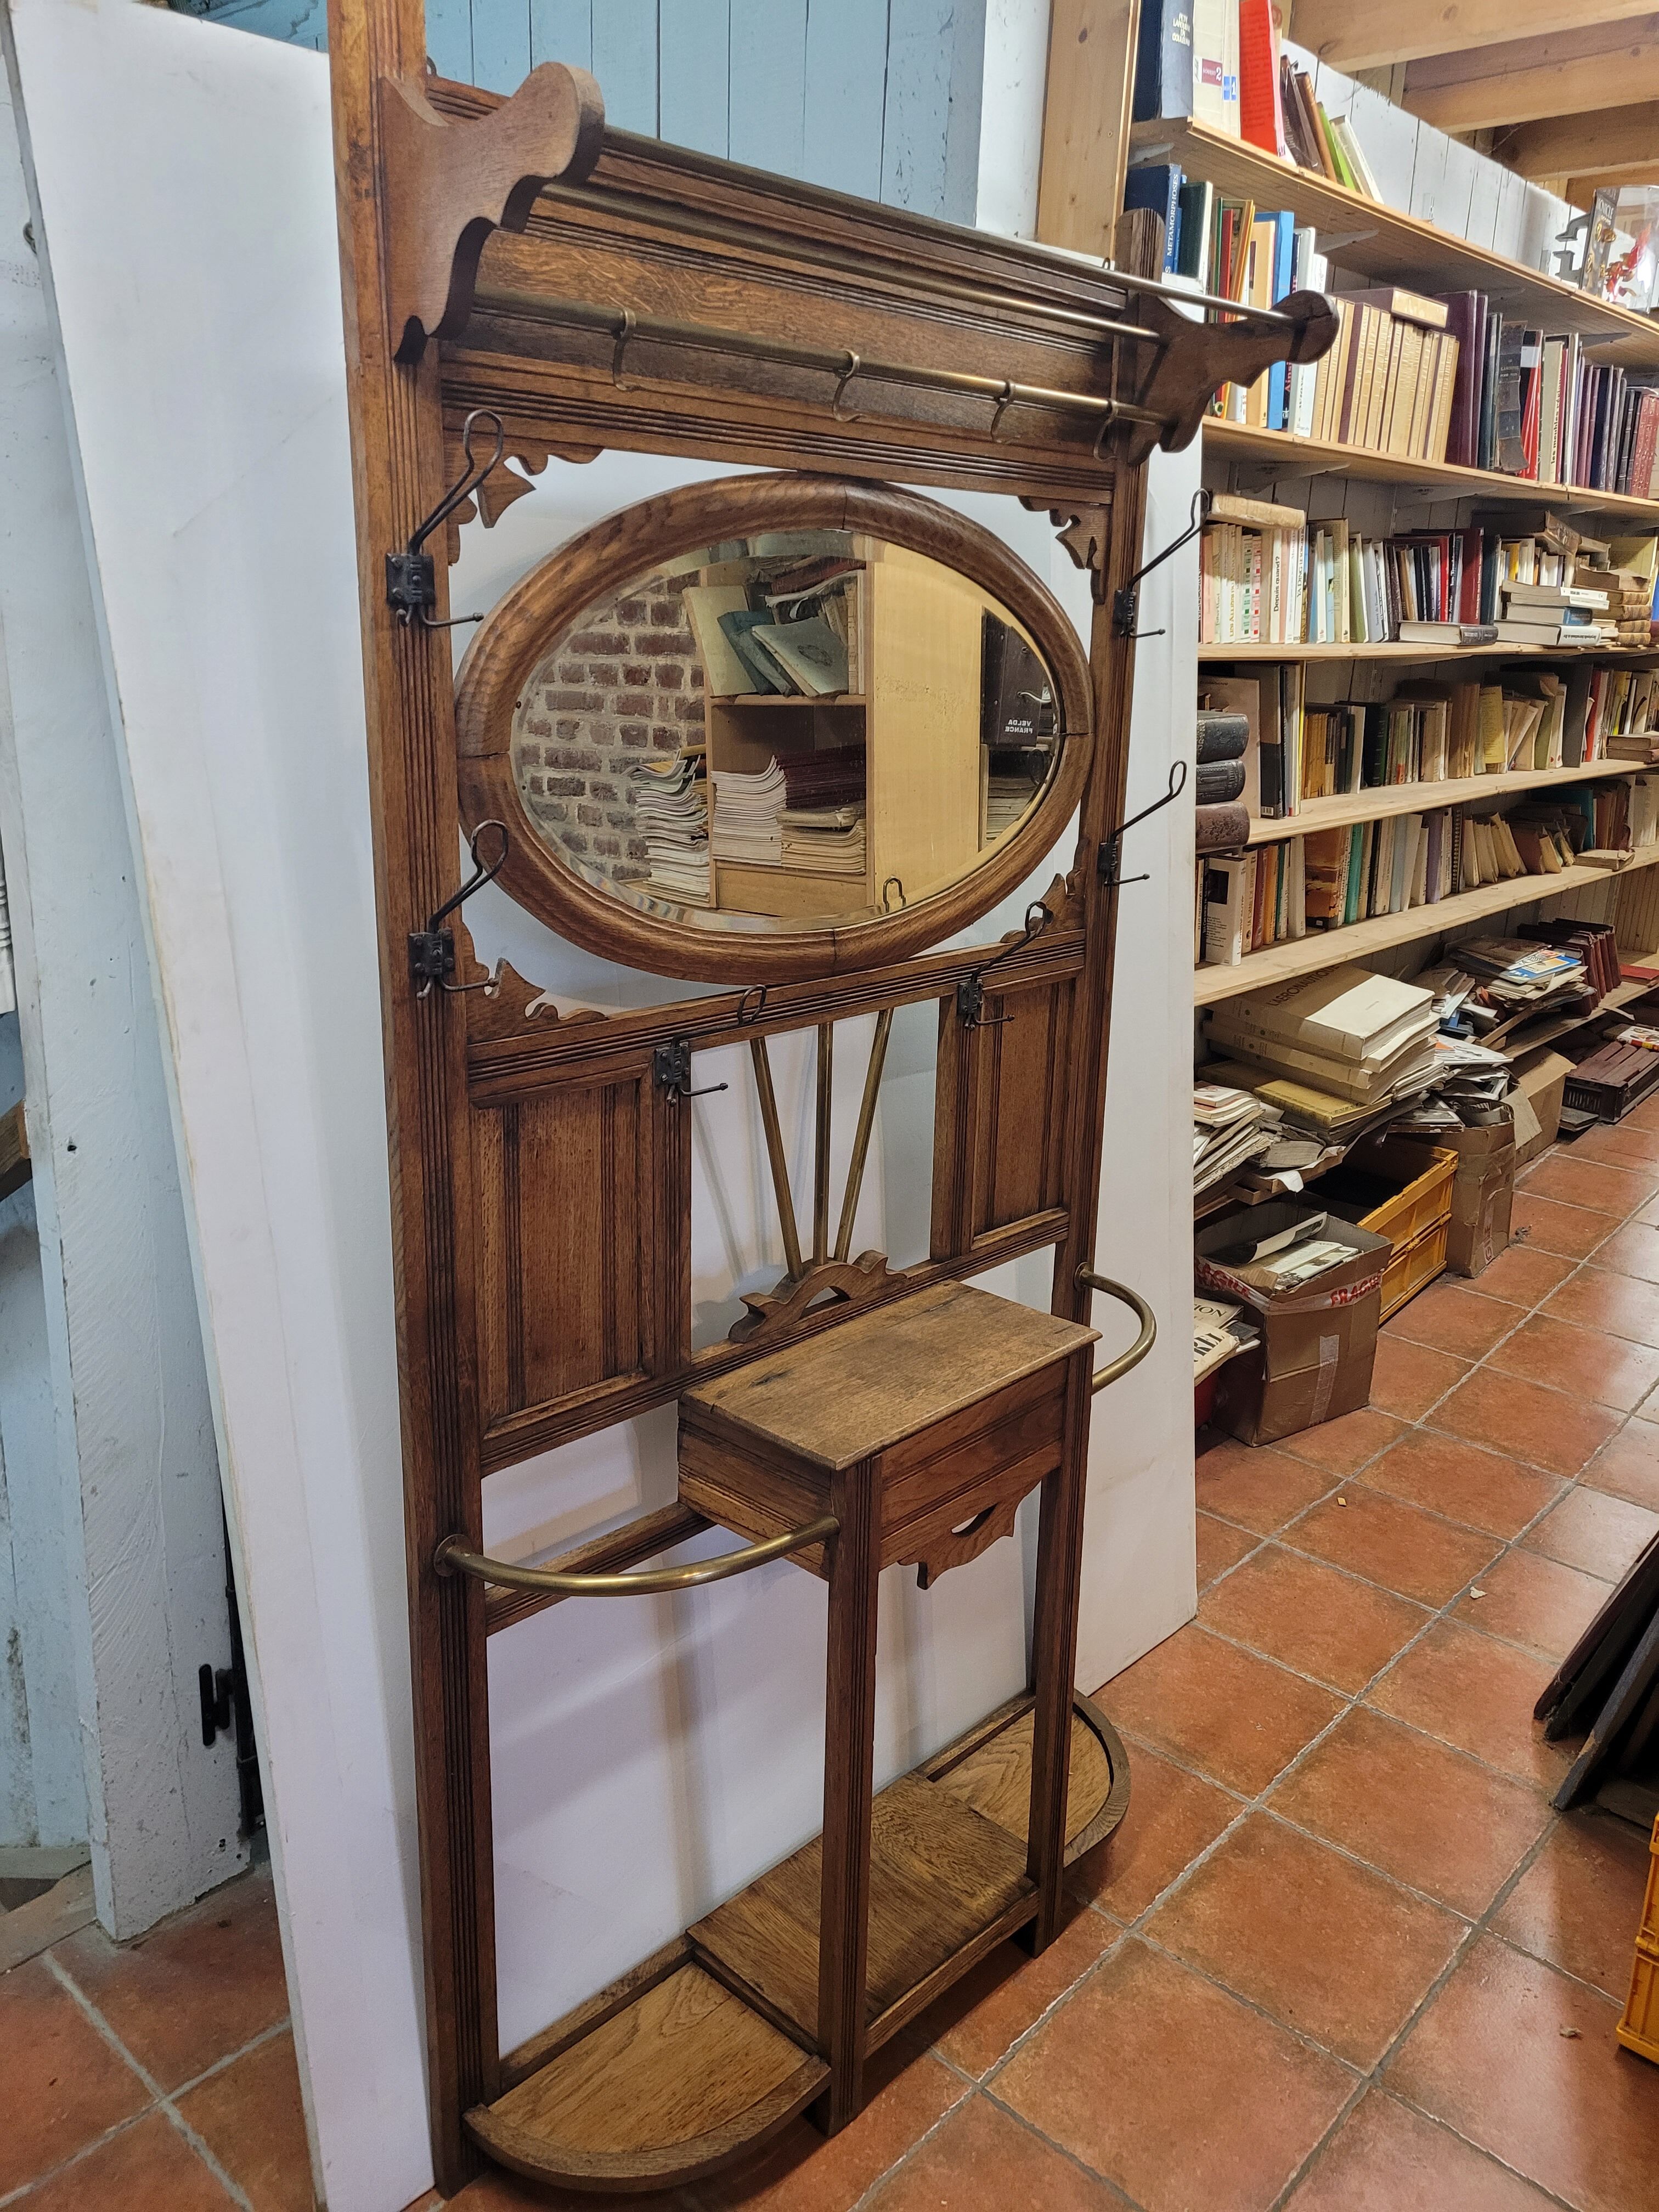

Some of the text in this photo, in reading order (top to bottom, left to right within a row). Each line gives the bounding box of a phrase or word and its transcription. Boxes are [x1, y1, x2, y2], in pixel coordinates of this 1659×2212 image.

[1216, 67, 1222, 81] 2
[1232, 82, 1235, 95] 1
[1167, 174, 1178, 256] METAMORPHOSES
[1297, 588, 1301, 597] YA
